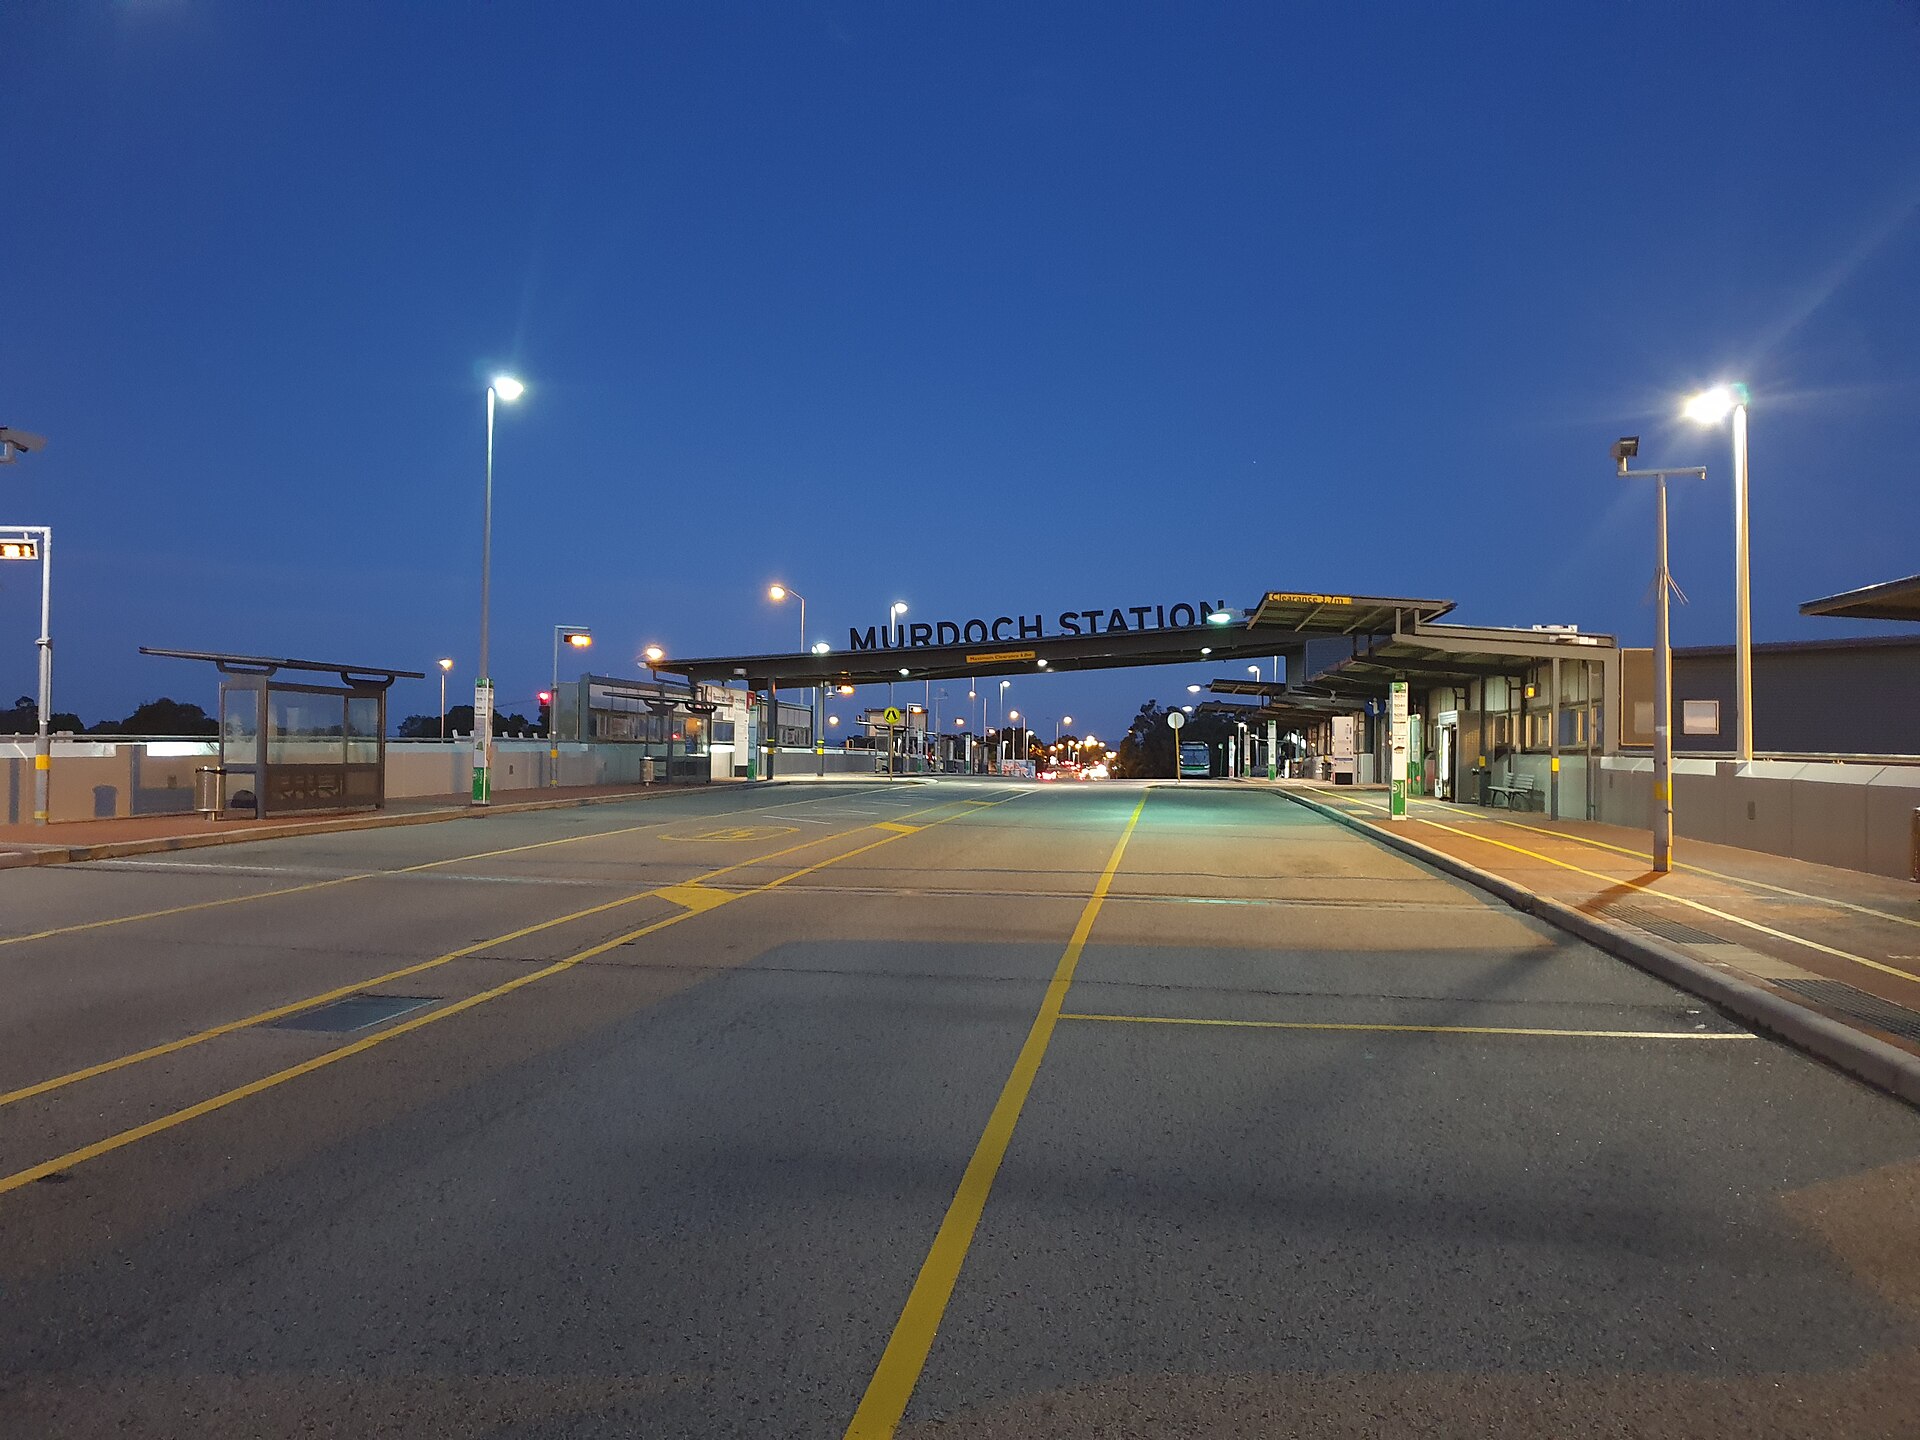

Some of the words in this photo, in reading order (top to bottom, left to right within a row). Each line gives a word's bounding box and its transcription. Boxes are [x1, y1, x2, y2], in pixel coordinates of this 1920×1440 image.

[1271, 592, 1318, 603] Clearance
[849, 614, 1043, 650] MURDOCH
[1059, 599, 1225, 636] STATION
